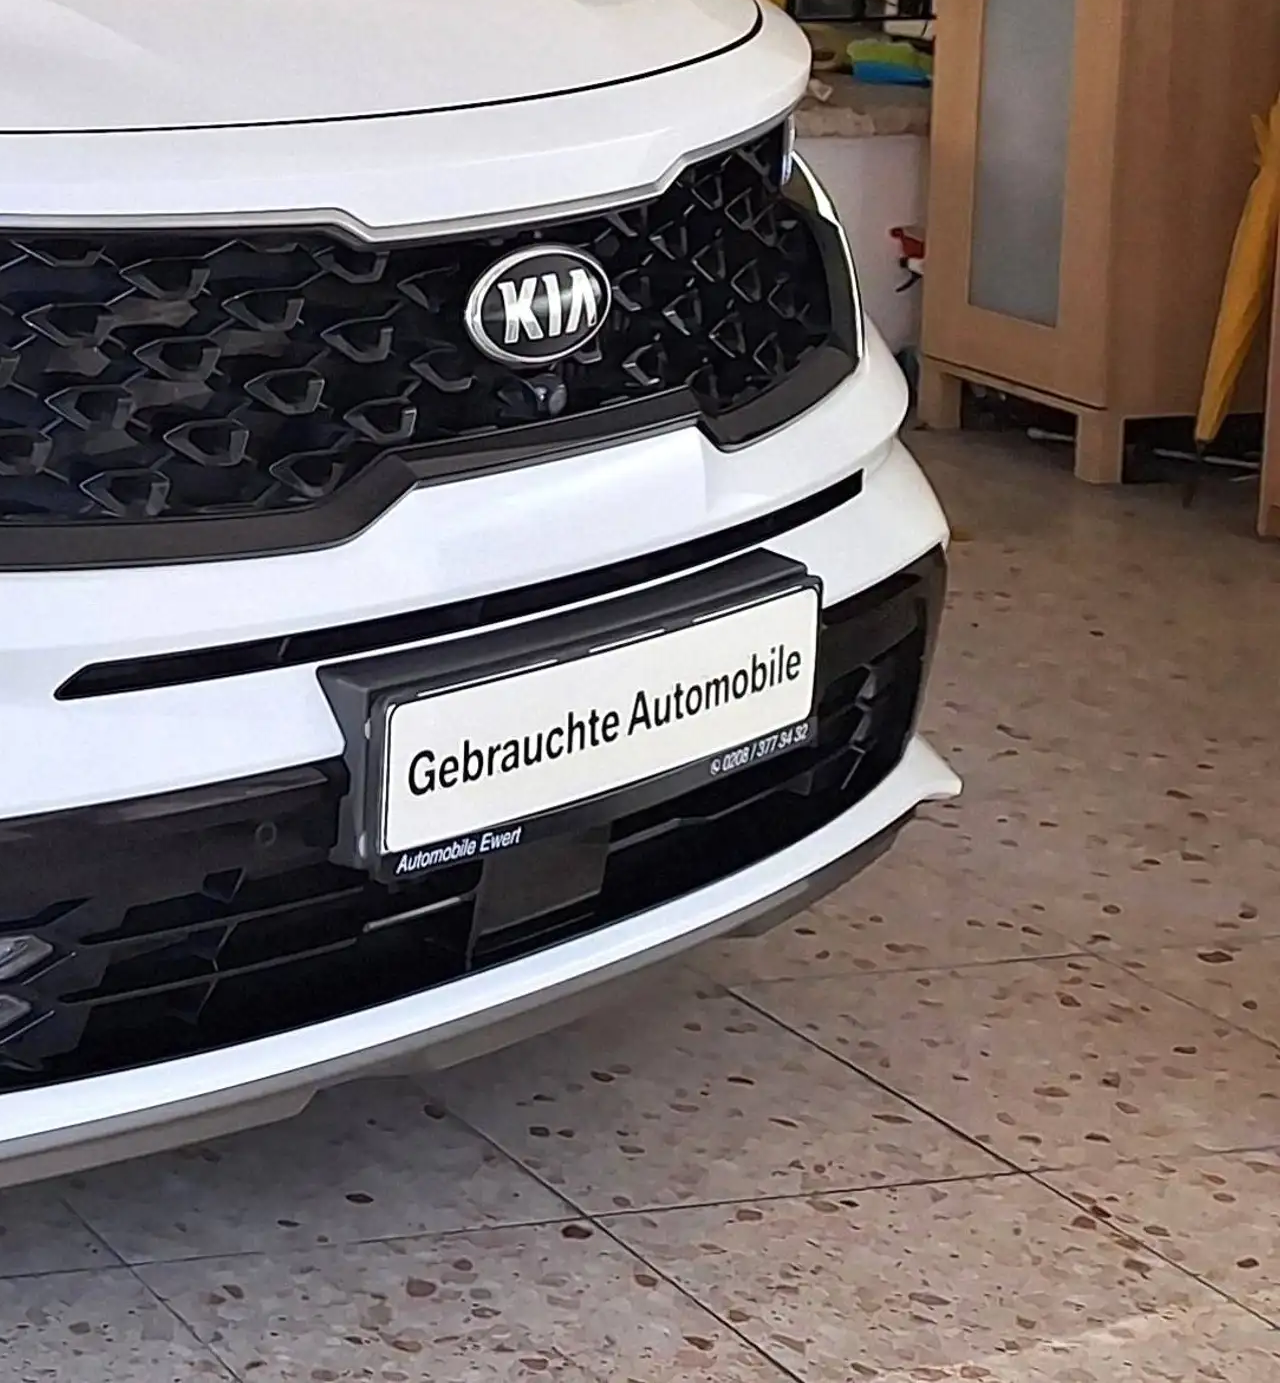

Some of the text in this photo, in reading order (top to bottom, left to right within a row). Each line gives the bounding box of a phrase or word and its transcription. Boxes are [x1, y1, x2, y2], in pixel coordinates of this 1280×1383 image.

[497, 267, 598, 344] KIA
[407, 645, 802, 796] Gebrauchte Automobile
[722, 746, 750, 772] 0208
[395, 826, 522, 874] Automobile Ewert
